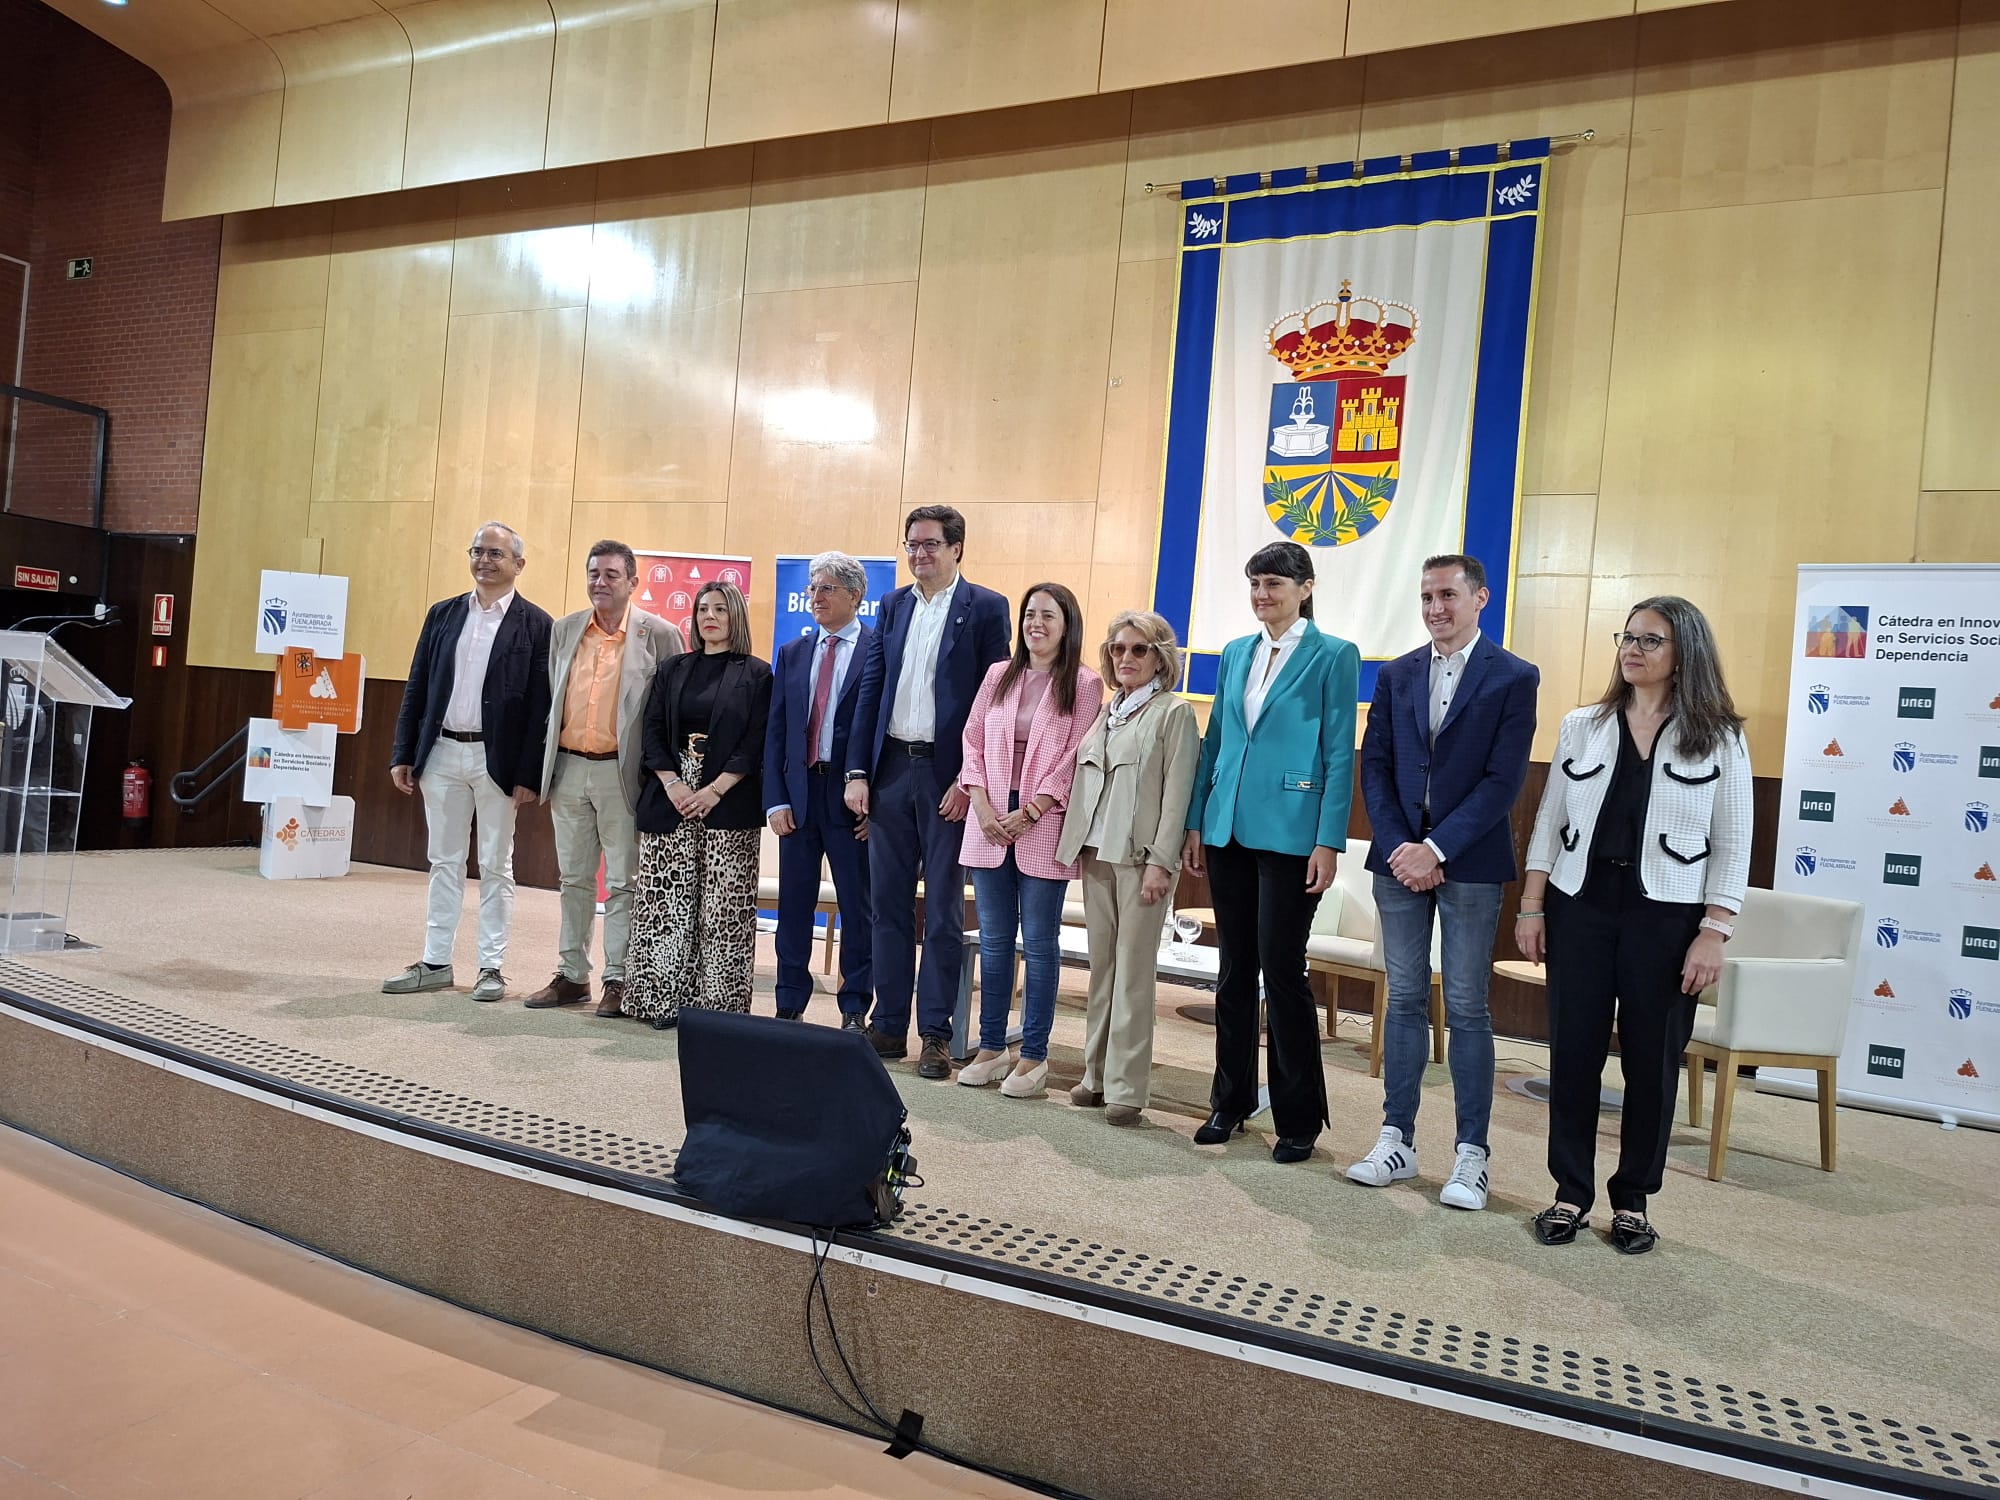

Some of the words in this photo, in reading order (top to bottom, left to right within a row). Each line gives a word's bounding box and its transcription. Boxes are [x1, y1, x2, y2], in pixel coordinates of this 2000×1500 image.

[17, 571, 30, 583] SIN
[31, 573, 57, 586] SALIDA
[291, 617, 332, 627] FUENLABRADA
[1878, 615, 1934, 627] Cátedra
[1937, 618, 1955, 628] en
[1876, 634, 1894, 643] en
[1898, 632, 1966, 645] Servicios
[1875, 648, 1969, 662] Dependencia
[1900, 698, 1932, 709] UNED
[1802, 800, 1832, 812] UNED
[1887, 863, 1918, 875] UNED
[1965, 937, 1997, 949] UNED
[1871, 1055, 1901, 1068] UNED
